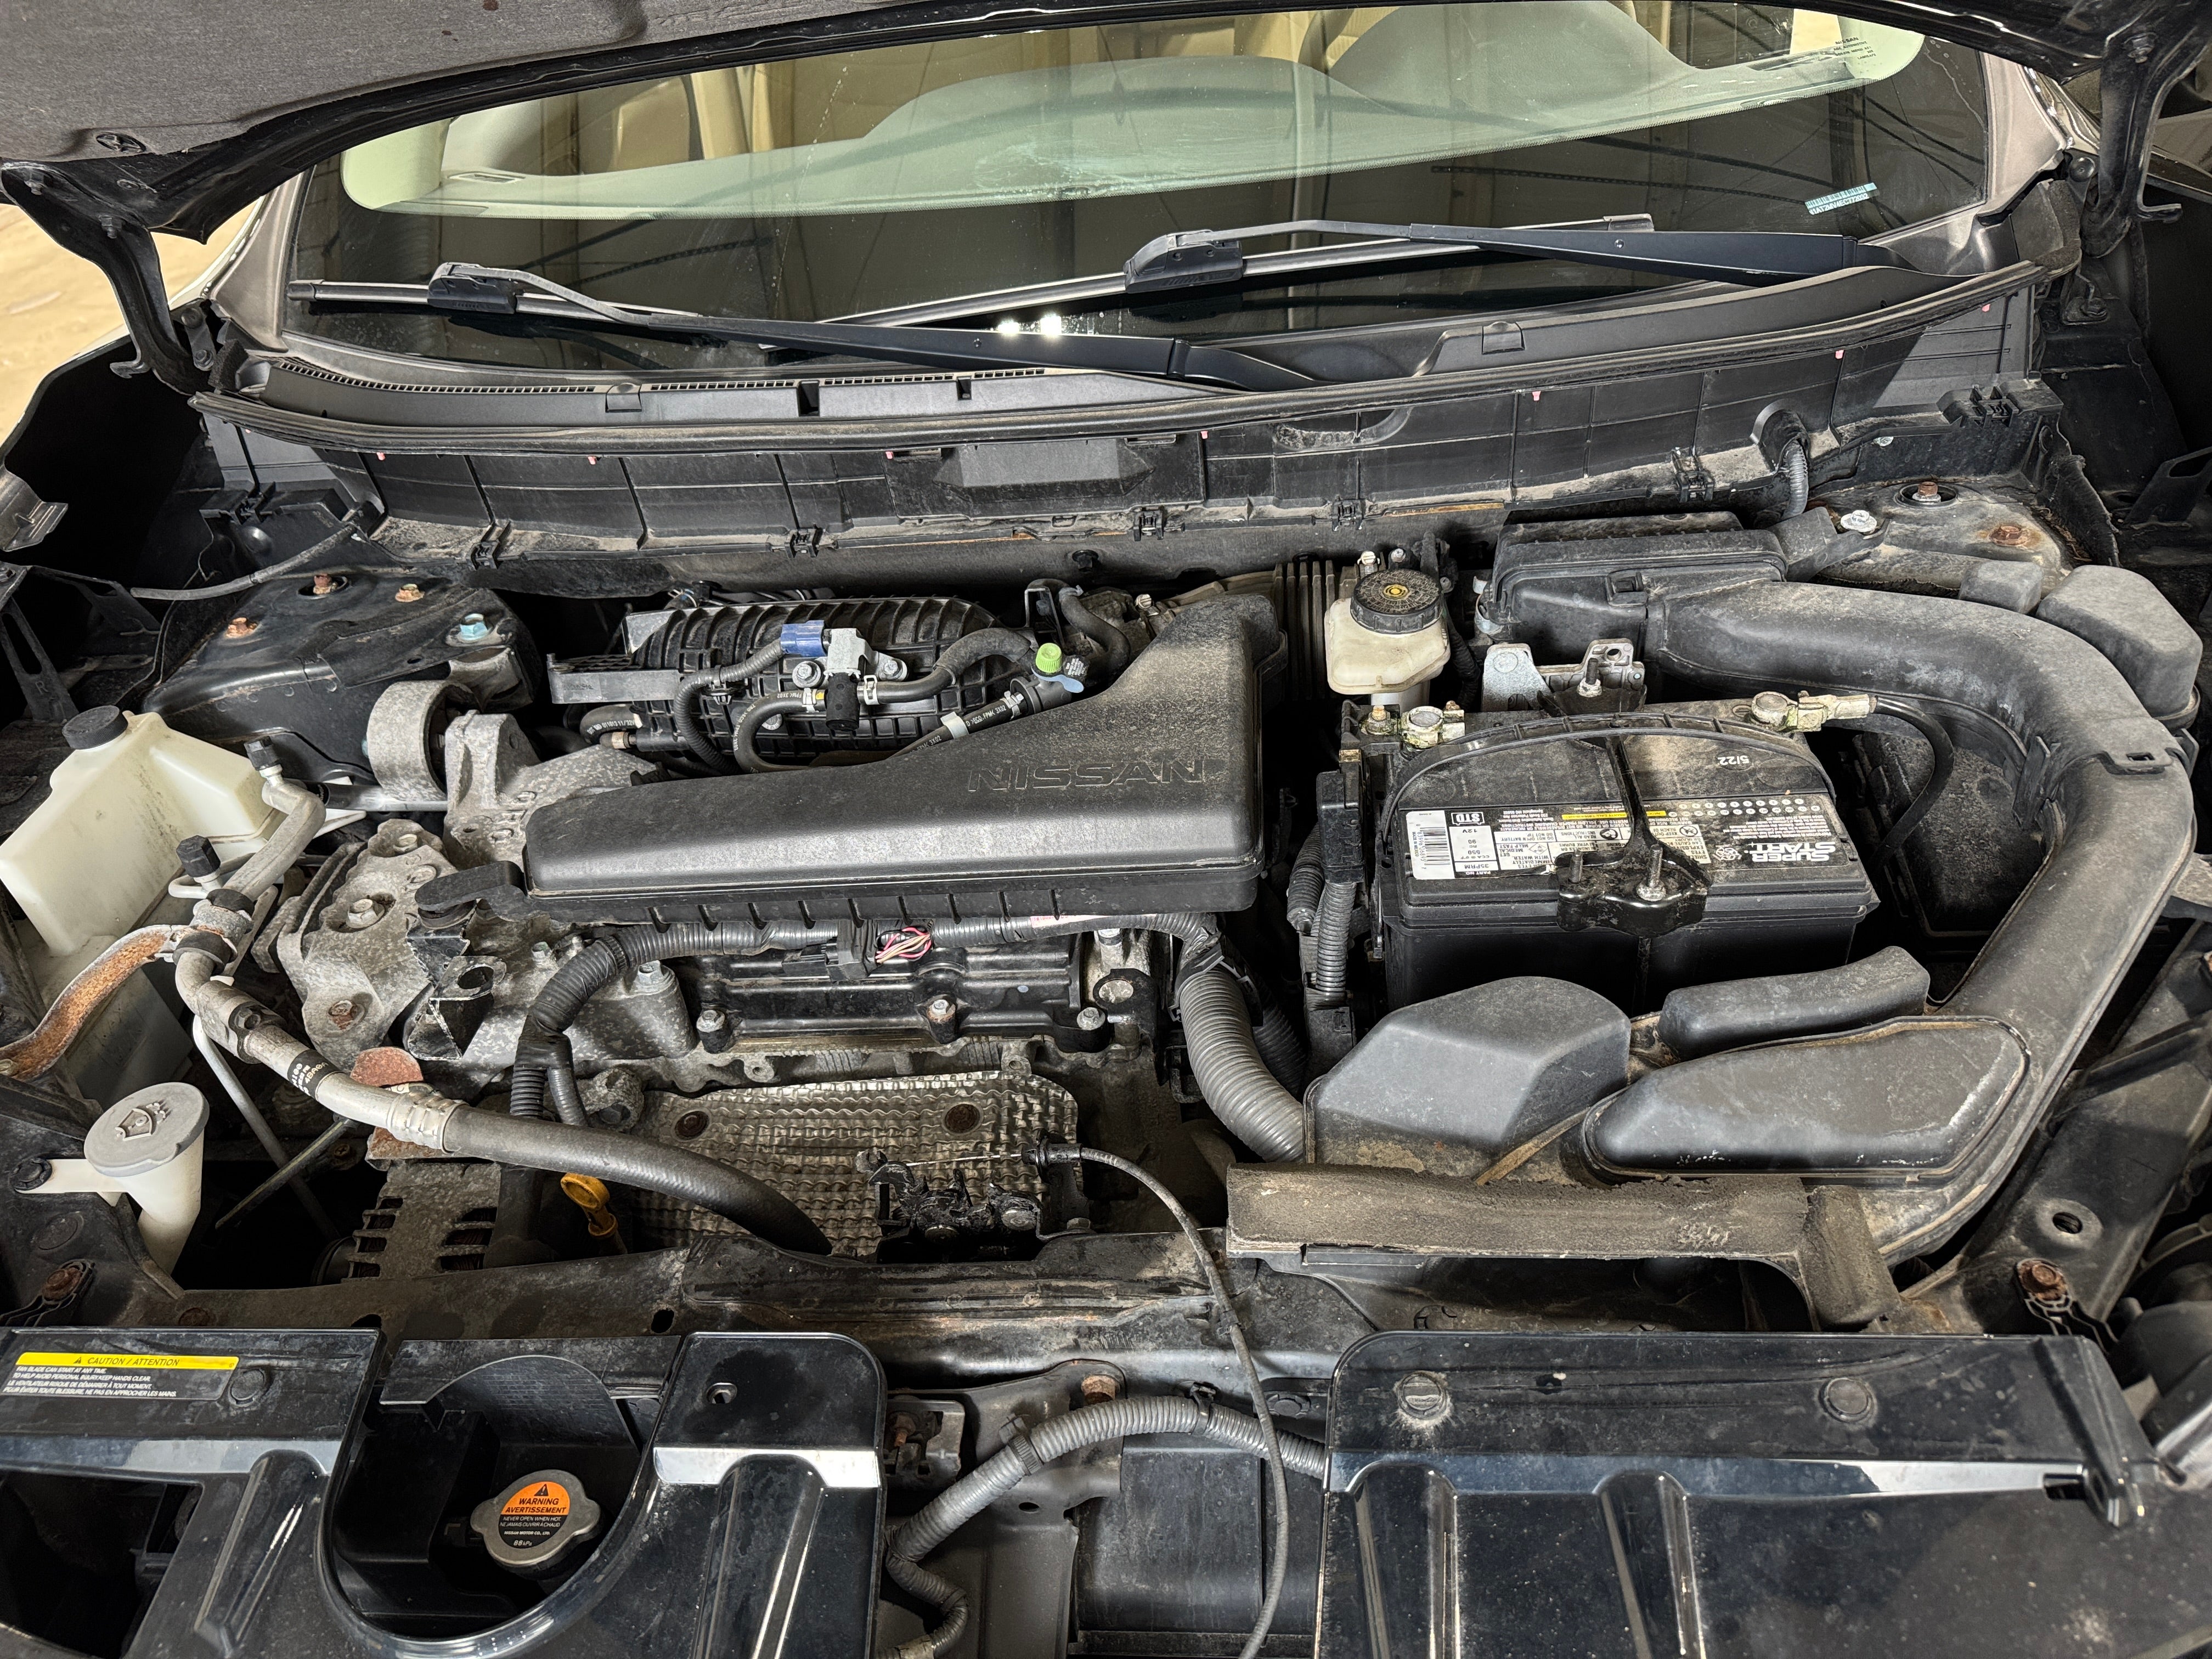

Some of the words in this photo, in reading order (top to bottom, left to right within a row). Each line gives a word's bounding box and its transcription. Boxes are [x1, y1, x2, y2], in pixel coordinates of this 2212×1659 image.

[35, 681, 48, 694] R
[995, 705, 1007, 714] 3X02
[929, 736, 942, 746] 3X02
[968, 758, 1205, 792] NISSAN
[1456, 814, 1480, 822] STD
[1752, 851, 1830, 862] SUPER
[88, 1357, 125, 1365] CAUTION
